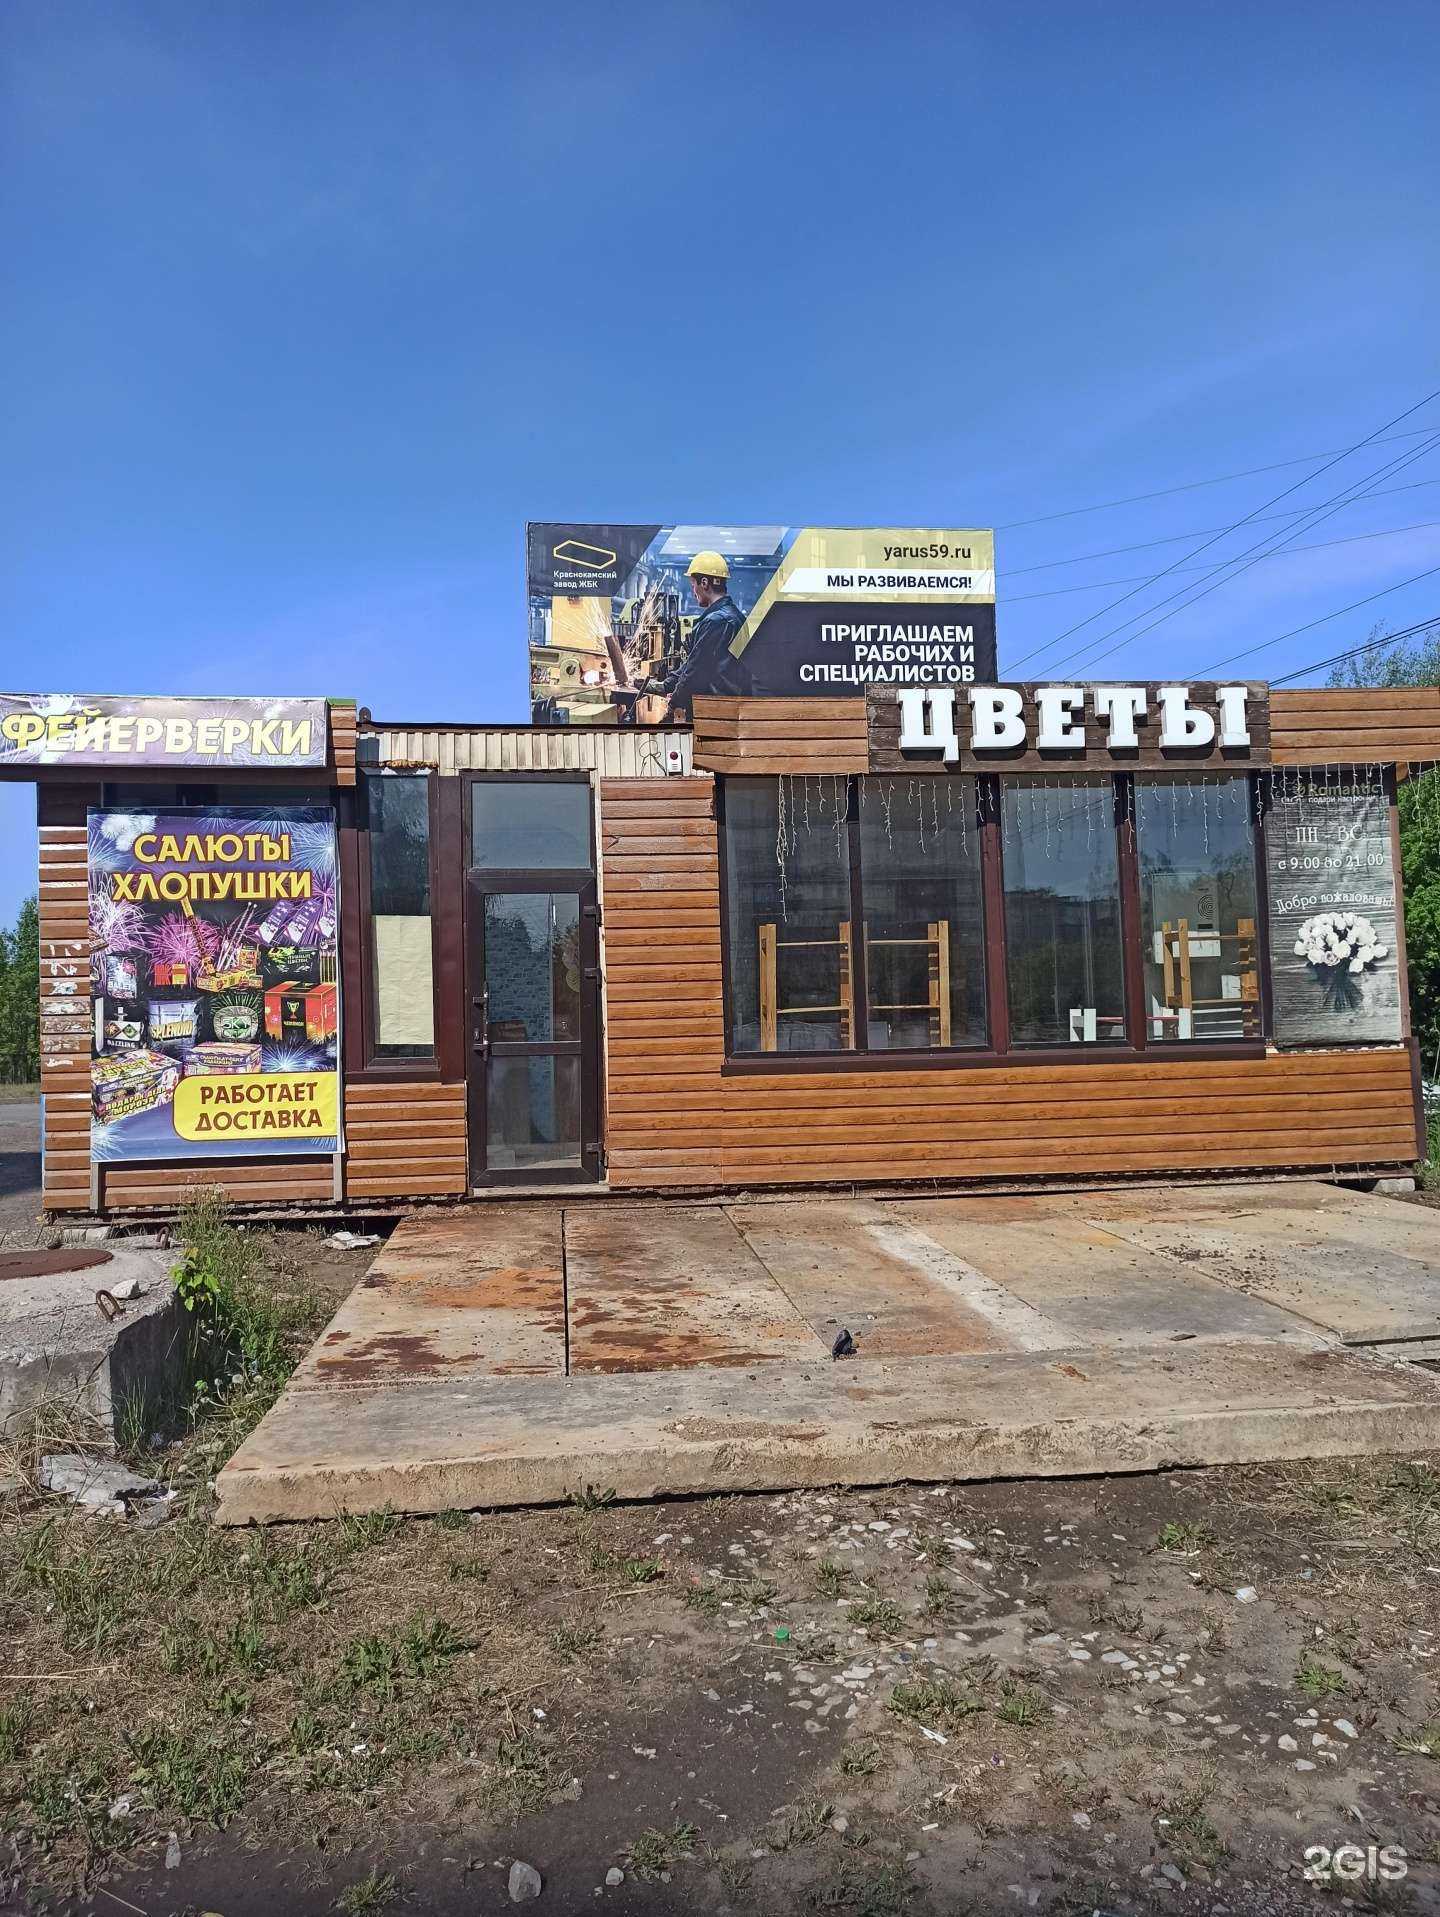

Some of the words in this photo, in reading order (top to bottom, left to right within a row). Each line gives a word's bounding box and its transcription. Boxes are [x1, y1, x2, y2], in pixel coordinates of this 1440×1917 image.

[883, 543, 972, 562] yarus59.ru
[553, 570, 617, 579] Краснокамский
[827, 575, 854, 587] МЫ
[858, 576, 972, 589] РАЗВИВАЕМСЯ!
[553, 580, 578, 589] завод
[579, 580, 598, 588] ЖБК
[821, 624, 974, 643] ПРИГЛАШАЕМ
[854, 644, 954, 663] РАБОЧИХ
[959, 645, 975, 663] И
[799, 664, 975, 686] СПЕЦИАЛИСТОВ
[0, 706, 314, 756] ФЕЙЕРВЕРКИ
[897, 686, 1252, 763] ЦВЕТЫ
[1307, 783, 1379, 796] Romantic
[1295, 826, 1320, 843] ПН
[1337, 825, 1363, 842] ВС
[133, 834, 292, 864] САЛЮТЫ
[1290, 857, 1320, 869] 9.00
[1346, 853, 1384, 867] 21.00
[111, 871, 314, 901] ХЛОПУШКИ
[1276, 895, 1318, 914] Добро
[200, 1081, 318, 1105] РАБОТАЕТ
[194, 1108, 323, 1132] ДОСТАВКА
